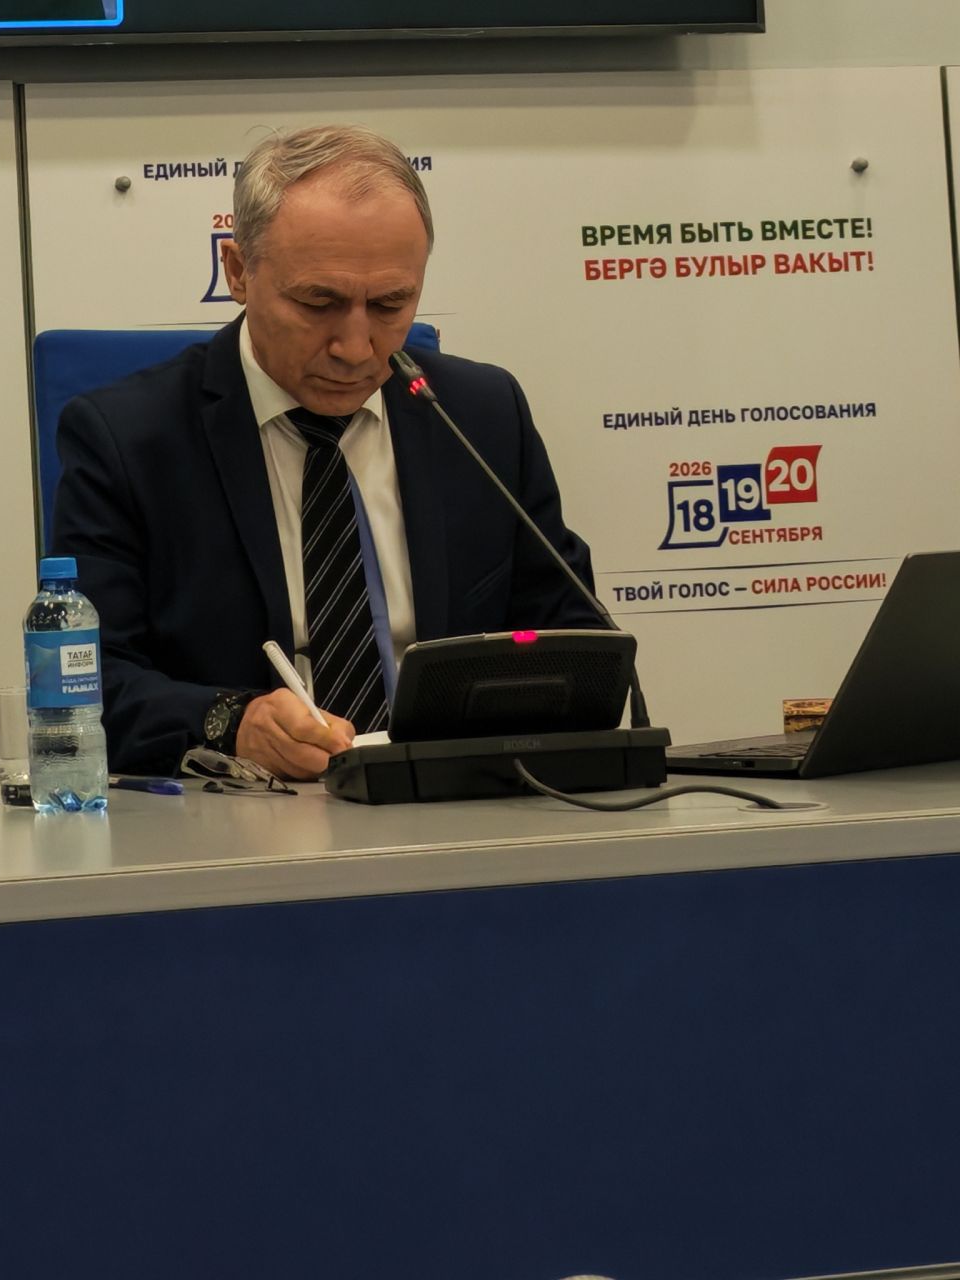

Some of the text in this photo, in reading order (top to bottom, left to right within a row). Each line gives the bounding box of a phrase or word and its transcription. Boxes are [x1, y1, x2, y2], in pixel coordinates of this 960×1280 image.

[144, 158, 227, 180] ЕДИНЫЙ
[213, 214, 233, 228] 20
[582, 218, 872, 246] ВРЕМЯ БЫТЬ ВМЕСТЕ!
[675, 255, 766, 277] БУЛЫР
[774, 251, 873, 274] ВАКЫТ!
[603, 403, 876, 430] ЕДИНЫЙ ДЕНЬ ГОЛОСОВАНИЯ
[670, 461, 711, 477] 2026
[676, 458, 815, 533] 18 19 20
[729, 526, 822, 545] СЕНТЯБРЯ
[613, 581, 663, 601] ТВОЙ
[669, 582, 729, 599] ГОЛОС
[752, 578, 801, 594] СИЛА
[806, 573, 886, 591] РОССИИ!
[67, 650, 93, 659] ТАТАР
